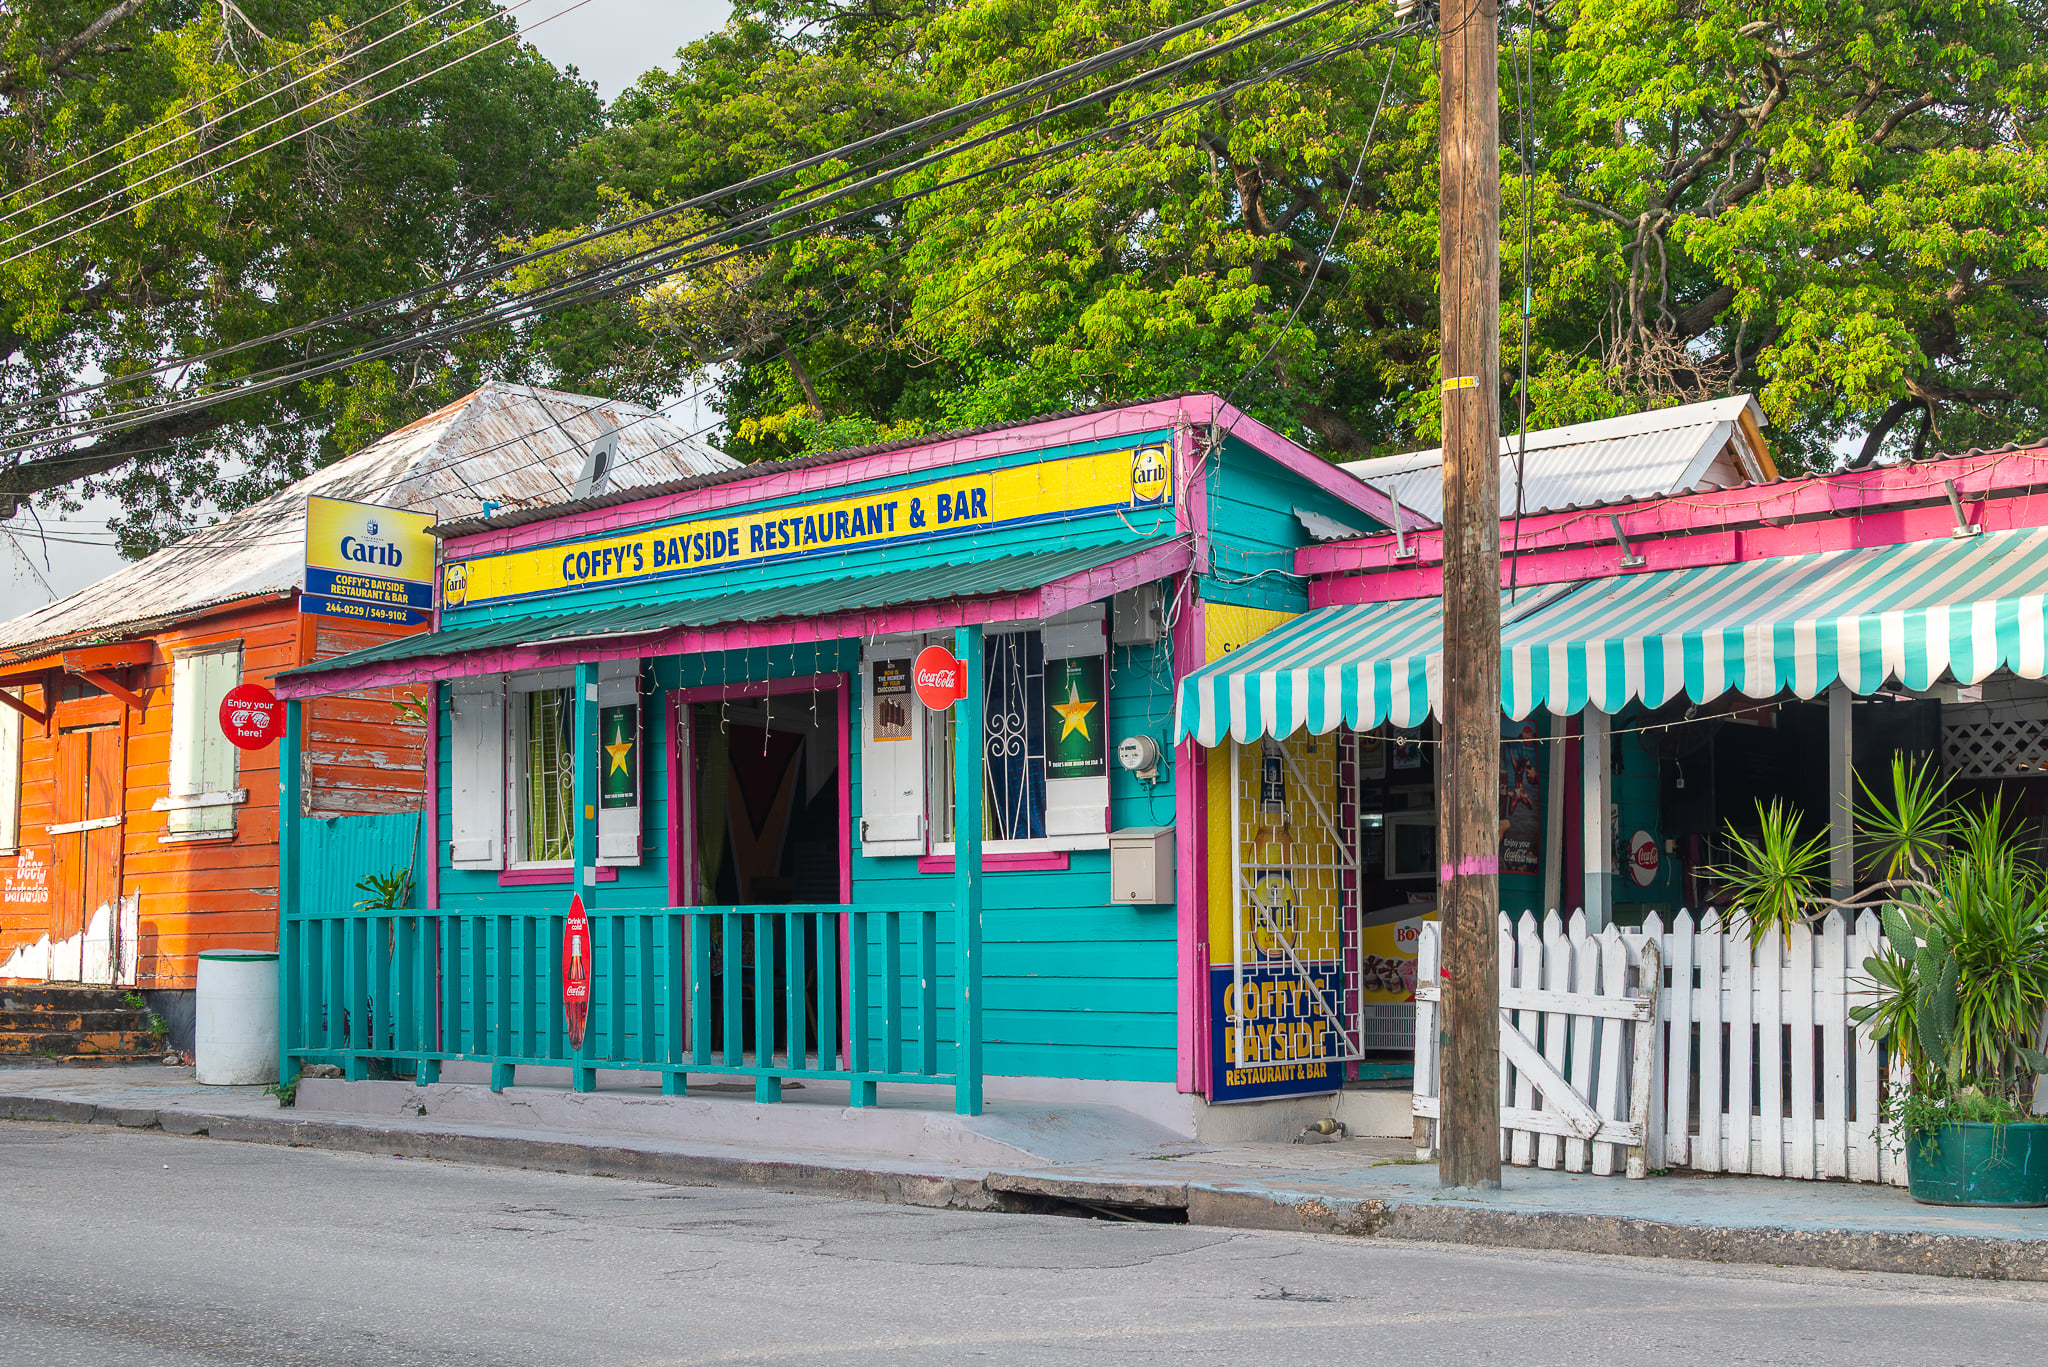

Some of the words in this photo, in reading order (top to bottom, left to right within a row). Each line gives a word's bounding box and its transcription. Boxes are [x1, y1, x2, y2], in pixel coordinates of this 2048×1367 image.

[1132, 464, 1165, 484] Carib
[562, 542, 644, 581] COFFY'S
[653, 527, 740, 568] BAYSIDE
[750, 501, 898, 553] RESTAURANT
[909, 497, 926, 529] &
[937, 487, 988, 524] BAR
[340, 536, 403, 567] Carib
[335, 574, 370, 588] COFFY'S
[371, 580, 405, 593] BAYSIDE
[446, 576, 466, 592] Carib
[330, 584, 384, 600] RESTAURANT
[384, 591, 391, 601] &
[391, 592, 409, 604] BAR
[326, 602, 364, 616] 244-0229
[365, 606, 370, 618] /
[371, 608, 407, 621] 549-9102
[917, 668, 957, 688] Coca-Cola
[227, 699, 252, 709] Enjoy
[253, 702, 274, 710] your
[237, 727, 262, 738] here!
[25, 848, 35, 860] The
[17, 855, 44, 880] Beer
[4, 878, 49, 903] Barbados
[567, 917, 582, 926] Drink
[1223, 978, 1326, 1020] COFFY'S
[1225, 1021, 1327, 1063] BAYSIDE
[1226, 1065, 1296, 1086] RESTAURANT
[1297, 1064, 1305, 1080] &
[1306, 1062, 1328, 1079] BAR
